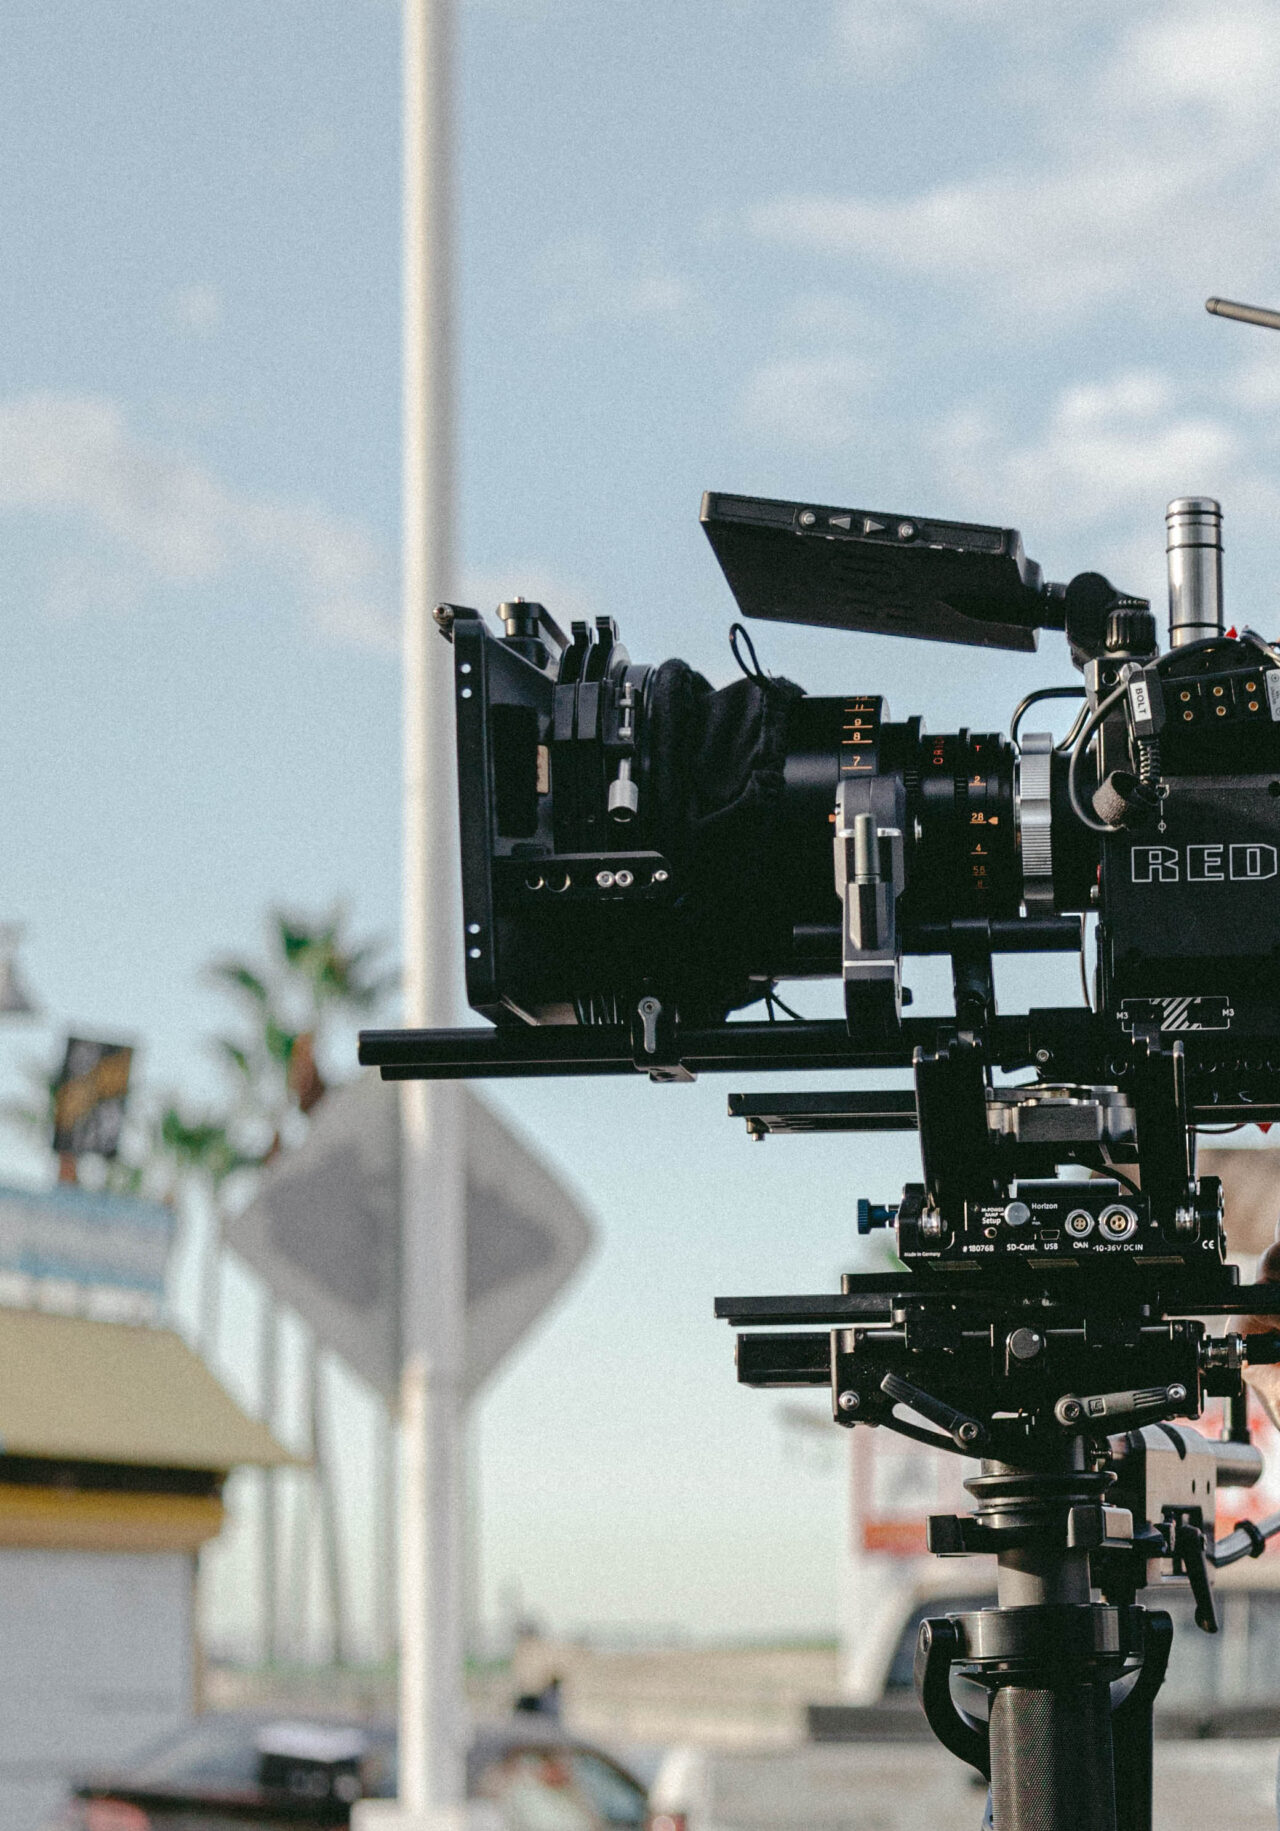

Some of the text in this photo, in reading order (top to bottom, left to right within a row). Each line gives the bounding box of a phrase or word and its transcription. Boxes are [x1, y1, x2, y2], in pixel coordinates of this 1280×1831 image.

[1135, 687, 1147, 714] BOLT
[854, 718, 862, 726] 9
[853, 732, 861, 741] 8
[853, 756, 861, 766] 7
[1132, 843, 1278, 882] RED
[1116, 1011, 1129, 1019] M3
[1222, 1008, 1235, 1016] M3
[982, 1217, 1002, 1226] Setup
[1006, 1243, 1035, 1251] SD-Card
[1202, 1240, 1215, 1249] CE
